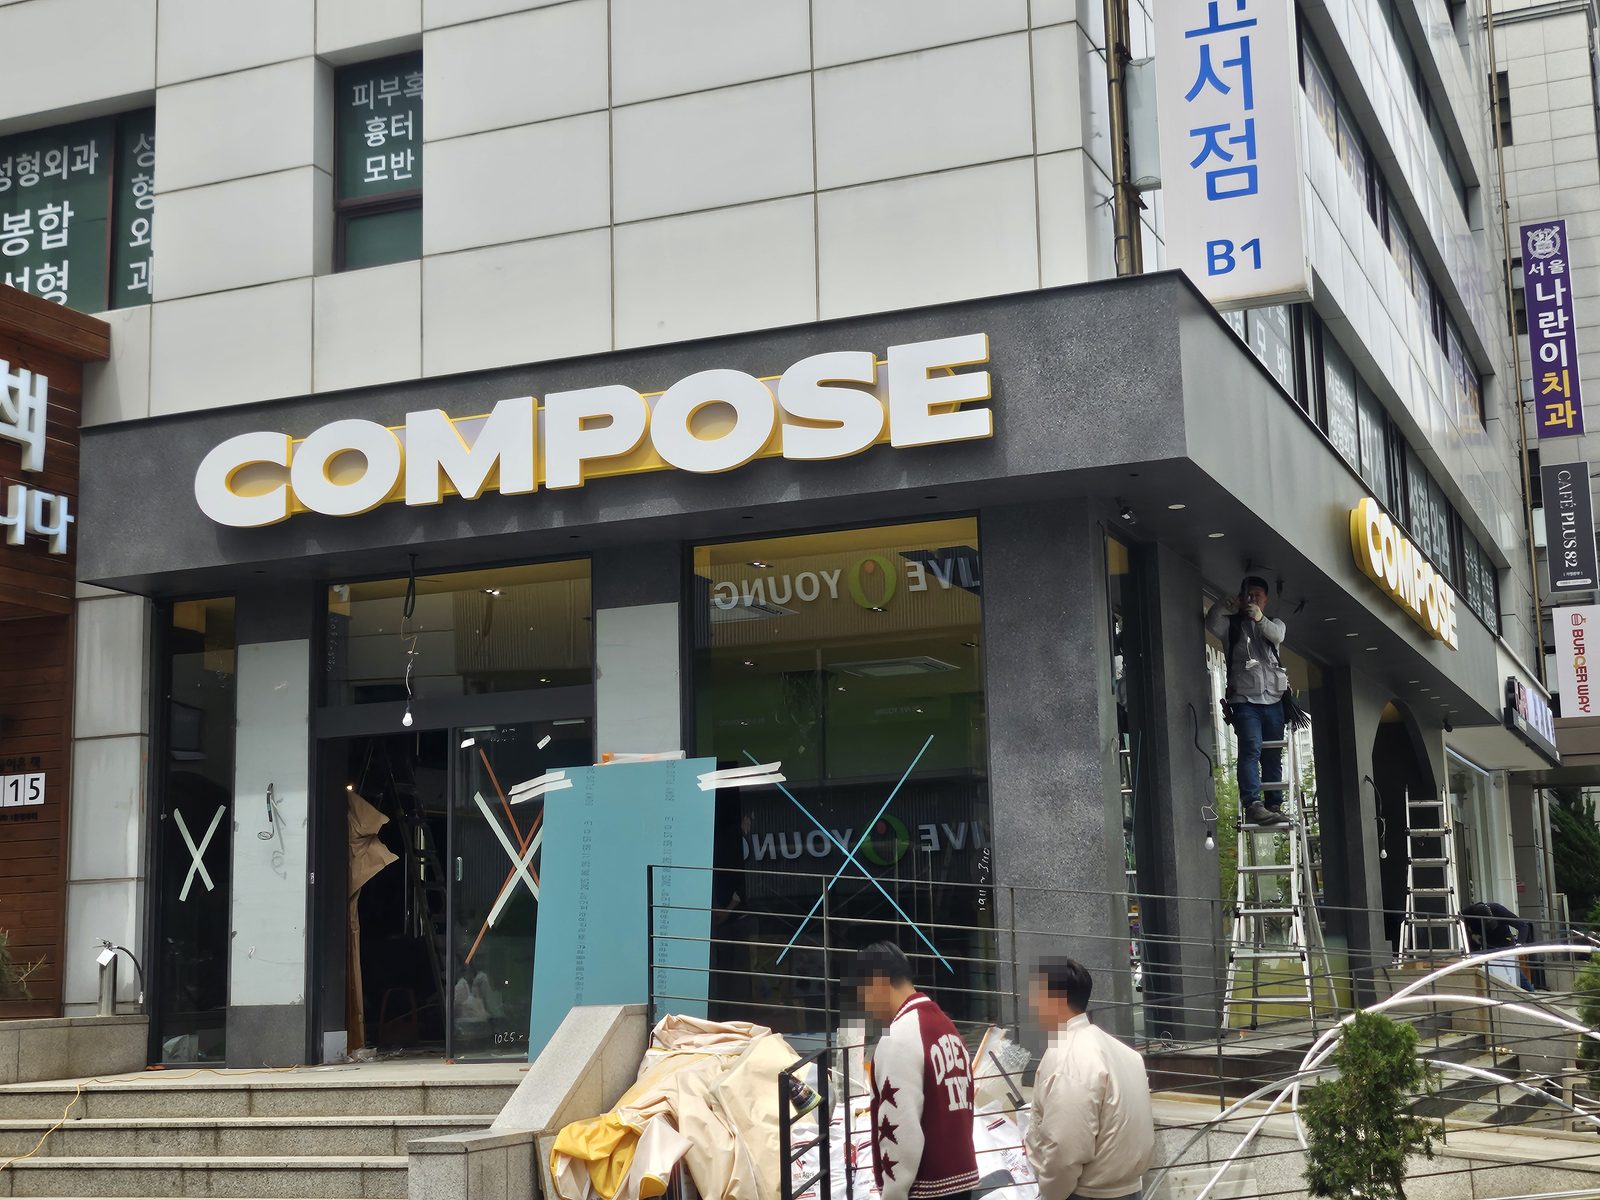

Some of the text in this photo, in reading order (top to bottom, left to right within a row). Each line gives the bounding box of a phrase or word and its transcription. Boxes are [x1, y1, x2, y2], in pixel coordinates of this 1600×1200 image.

[364, 110, 413, 147] 흉터
[0, 139, 99, 192] 성형외과
[364, 148, 415, 183] 모반
[0, 200, 75, 257] 봉합
[1206, 238, 1262, 277] B1
[1528, 259, 1566, 277] 서울
[1535, 278, 1577, 430] 나란이치과
[193, 332, 995, 529] COMPOSE
[1557, 470, 1577, 509] CAFÉ
[1560, 511, 1578, 550] PLUS
[1355, 497, 1459, 651] COMPOSE
[1563, 550, 1578, 568] 82
[1577, 684, 1591, 713] WAY
